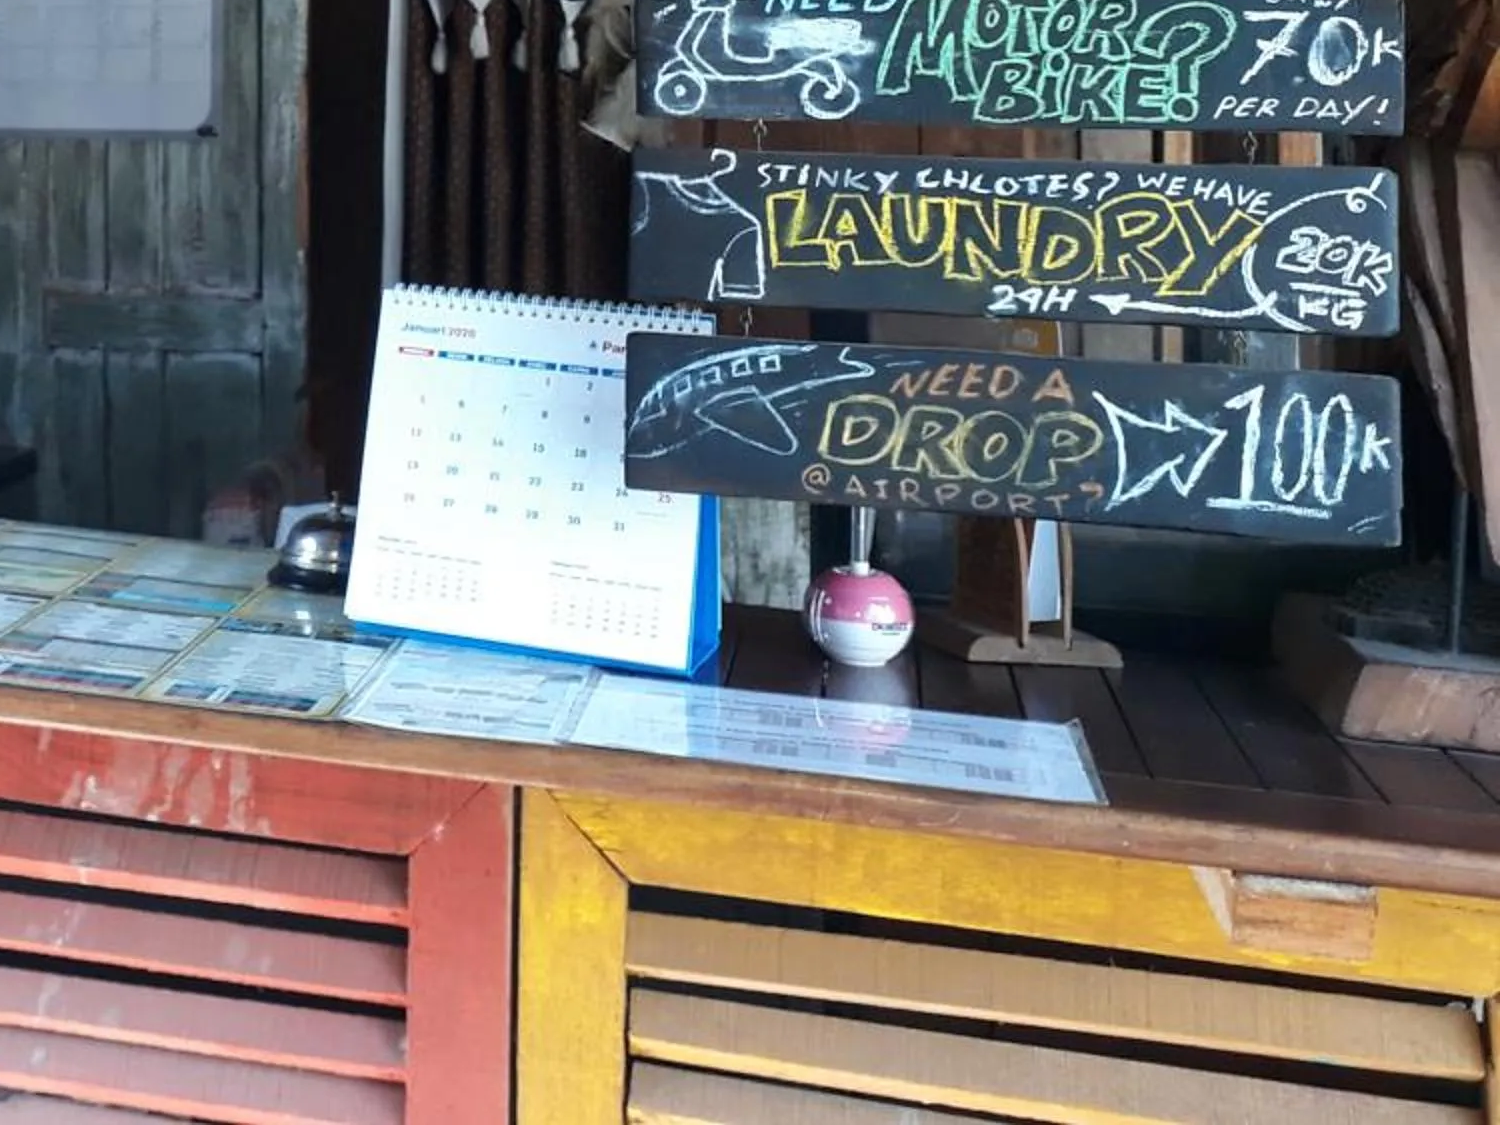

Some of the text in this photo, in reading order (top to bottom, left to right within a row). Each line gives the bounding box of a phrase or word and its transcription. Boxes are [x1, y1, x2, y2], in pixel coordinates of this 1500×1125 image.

[1213, 95, 1389, 125] PER DAY!
[758, 163, 899, 194] STINKY
[1137, 172, 1187, 196] WE
[1193, 179, 1272, 215] HAVE
[767, 188, 1263, 296] LAUNDRY
[1299, 295, 1367, 330] KG
[890, 363, 1074, 406] NEED A
[817, 394, 1104, 489] DROP
